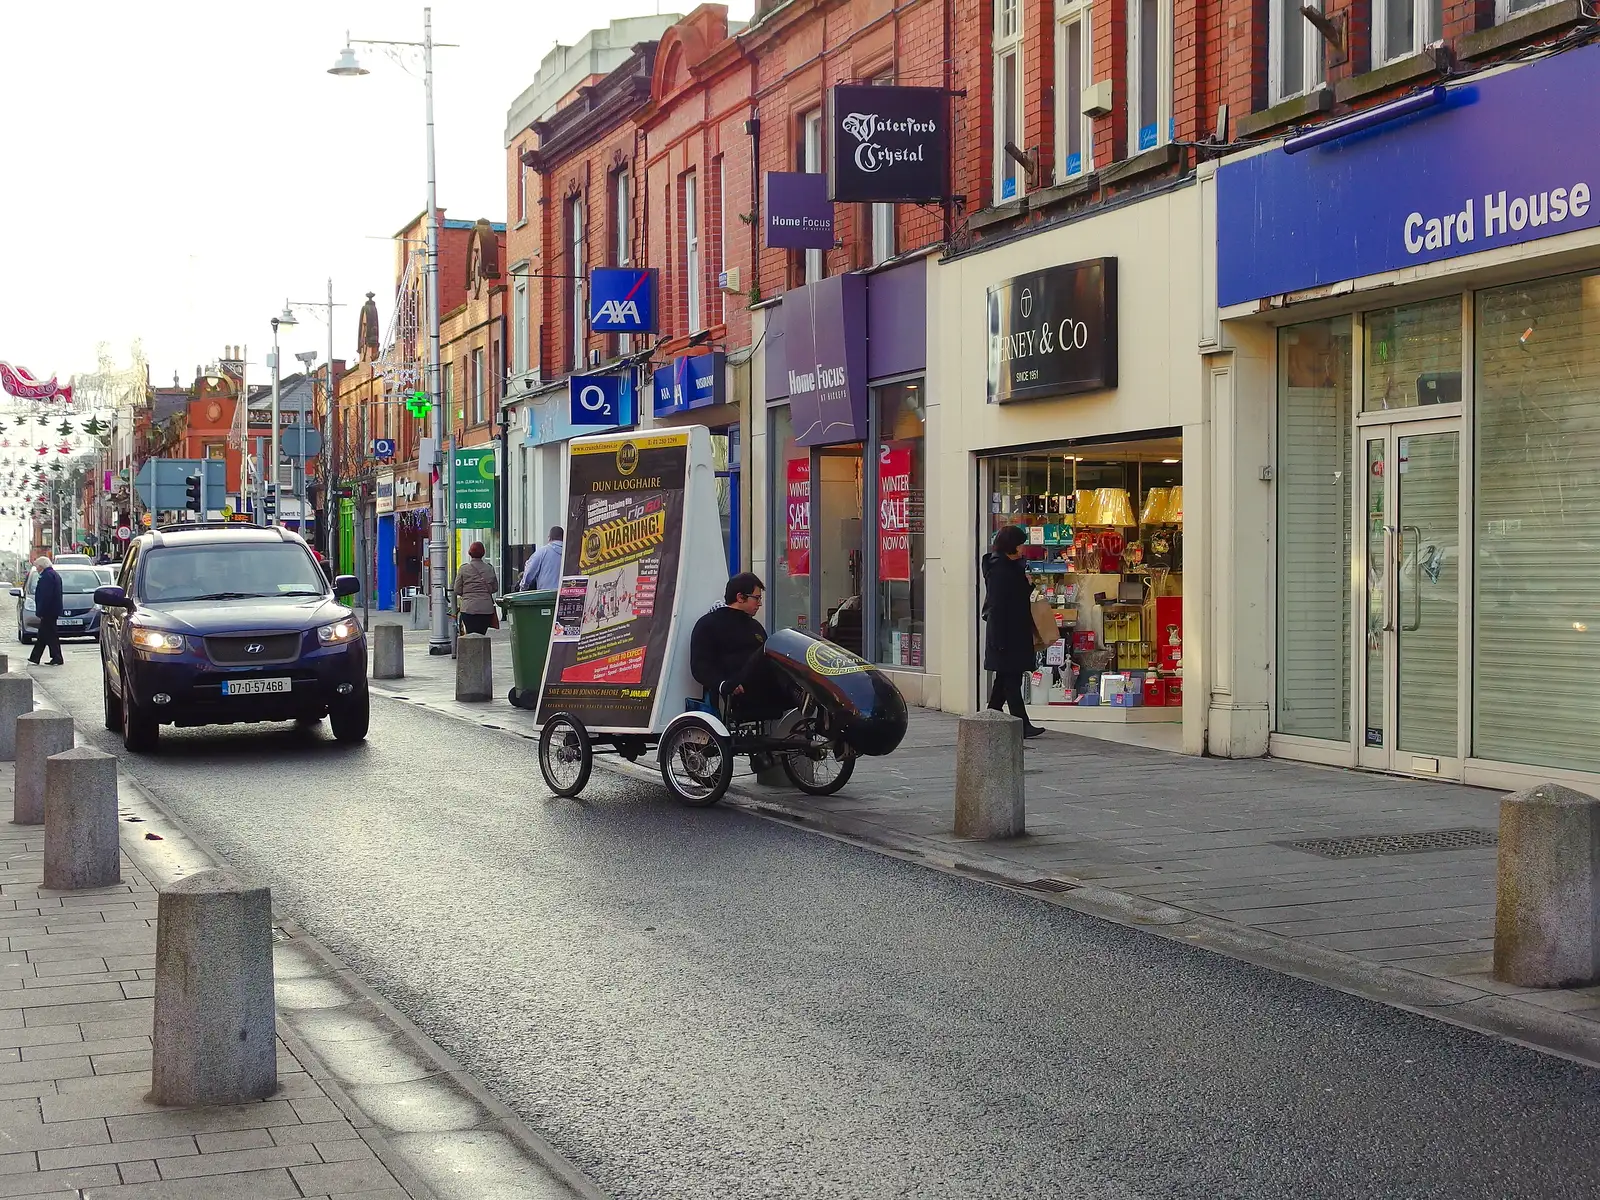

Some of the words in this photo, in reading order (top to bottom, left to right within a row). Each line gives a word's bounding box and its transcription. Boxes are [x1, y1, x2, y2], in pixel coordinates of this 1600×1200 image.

[842, 112, 936, 142] Waterford
[854, 142, 924, 173] Crystal
[772, 215, 800, 226] Home
[802, 216, 831, 227] Focus
[1404, 198, 1475, 254] Card
[1484, 182, 1591, 238] House
[592, 300, 641, 324] AXA
[1039, 322, 1054, 355] &
[788, 369, 816, 395] Home
[816, 364, 845, 390] Focus
[1016, 371, 1029, 382] SINCE
[1029, 369, 1039, 380] 1951
[580, 385, 611, 415] O2
[376, 440, 392, 456] O2
[464, 458, 479, 466] LET
[592, 480, 611, 492] DUN
[614, 476, 661, 491] LAOGHAIRE
[789, 481, 810, 497] WINTE
[881, 474, 909, 493] WINTER
[628, 505, 645, 519] rip
[881, 497, 909, 530] SALE
[605, 514, 660, 549] WARNING!
[882, 537, 898, 550] NOW
[899, 536, 909, 549] ON
[627, 648, 643, 658] EXPECT
